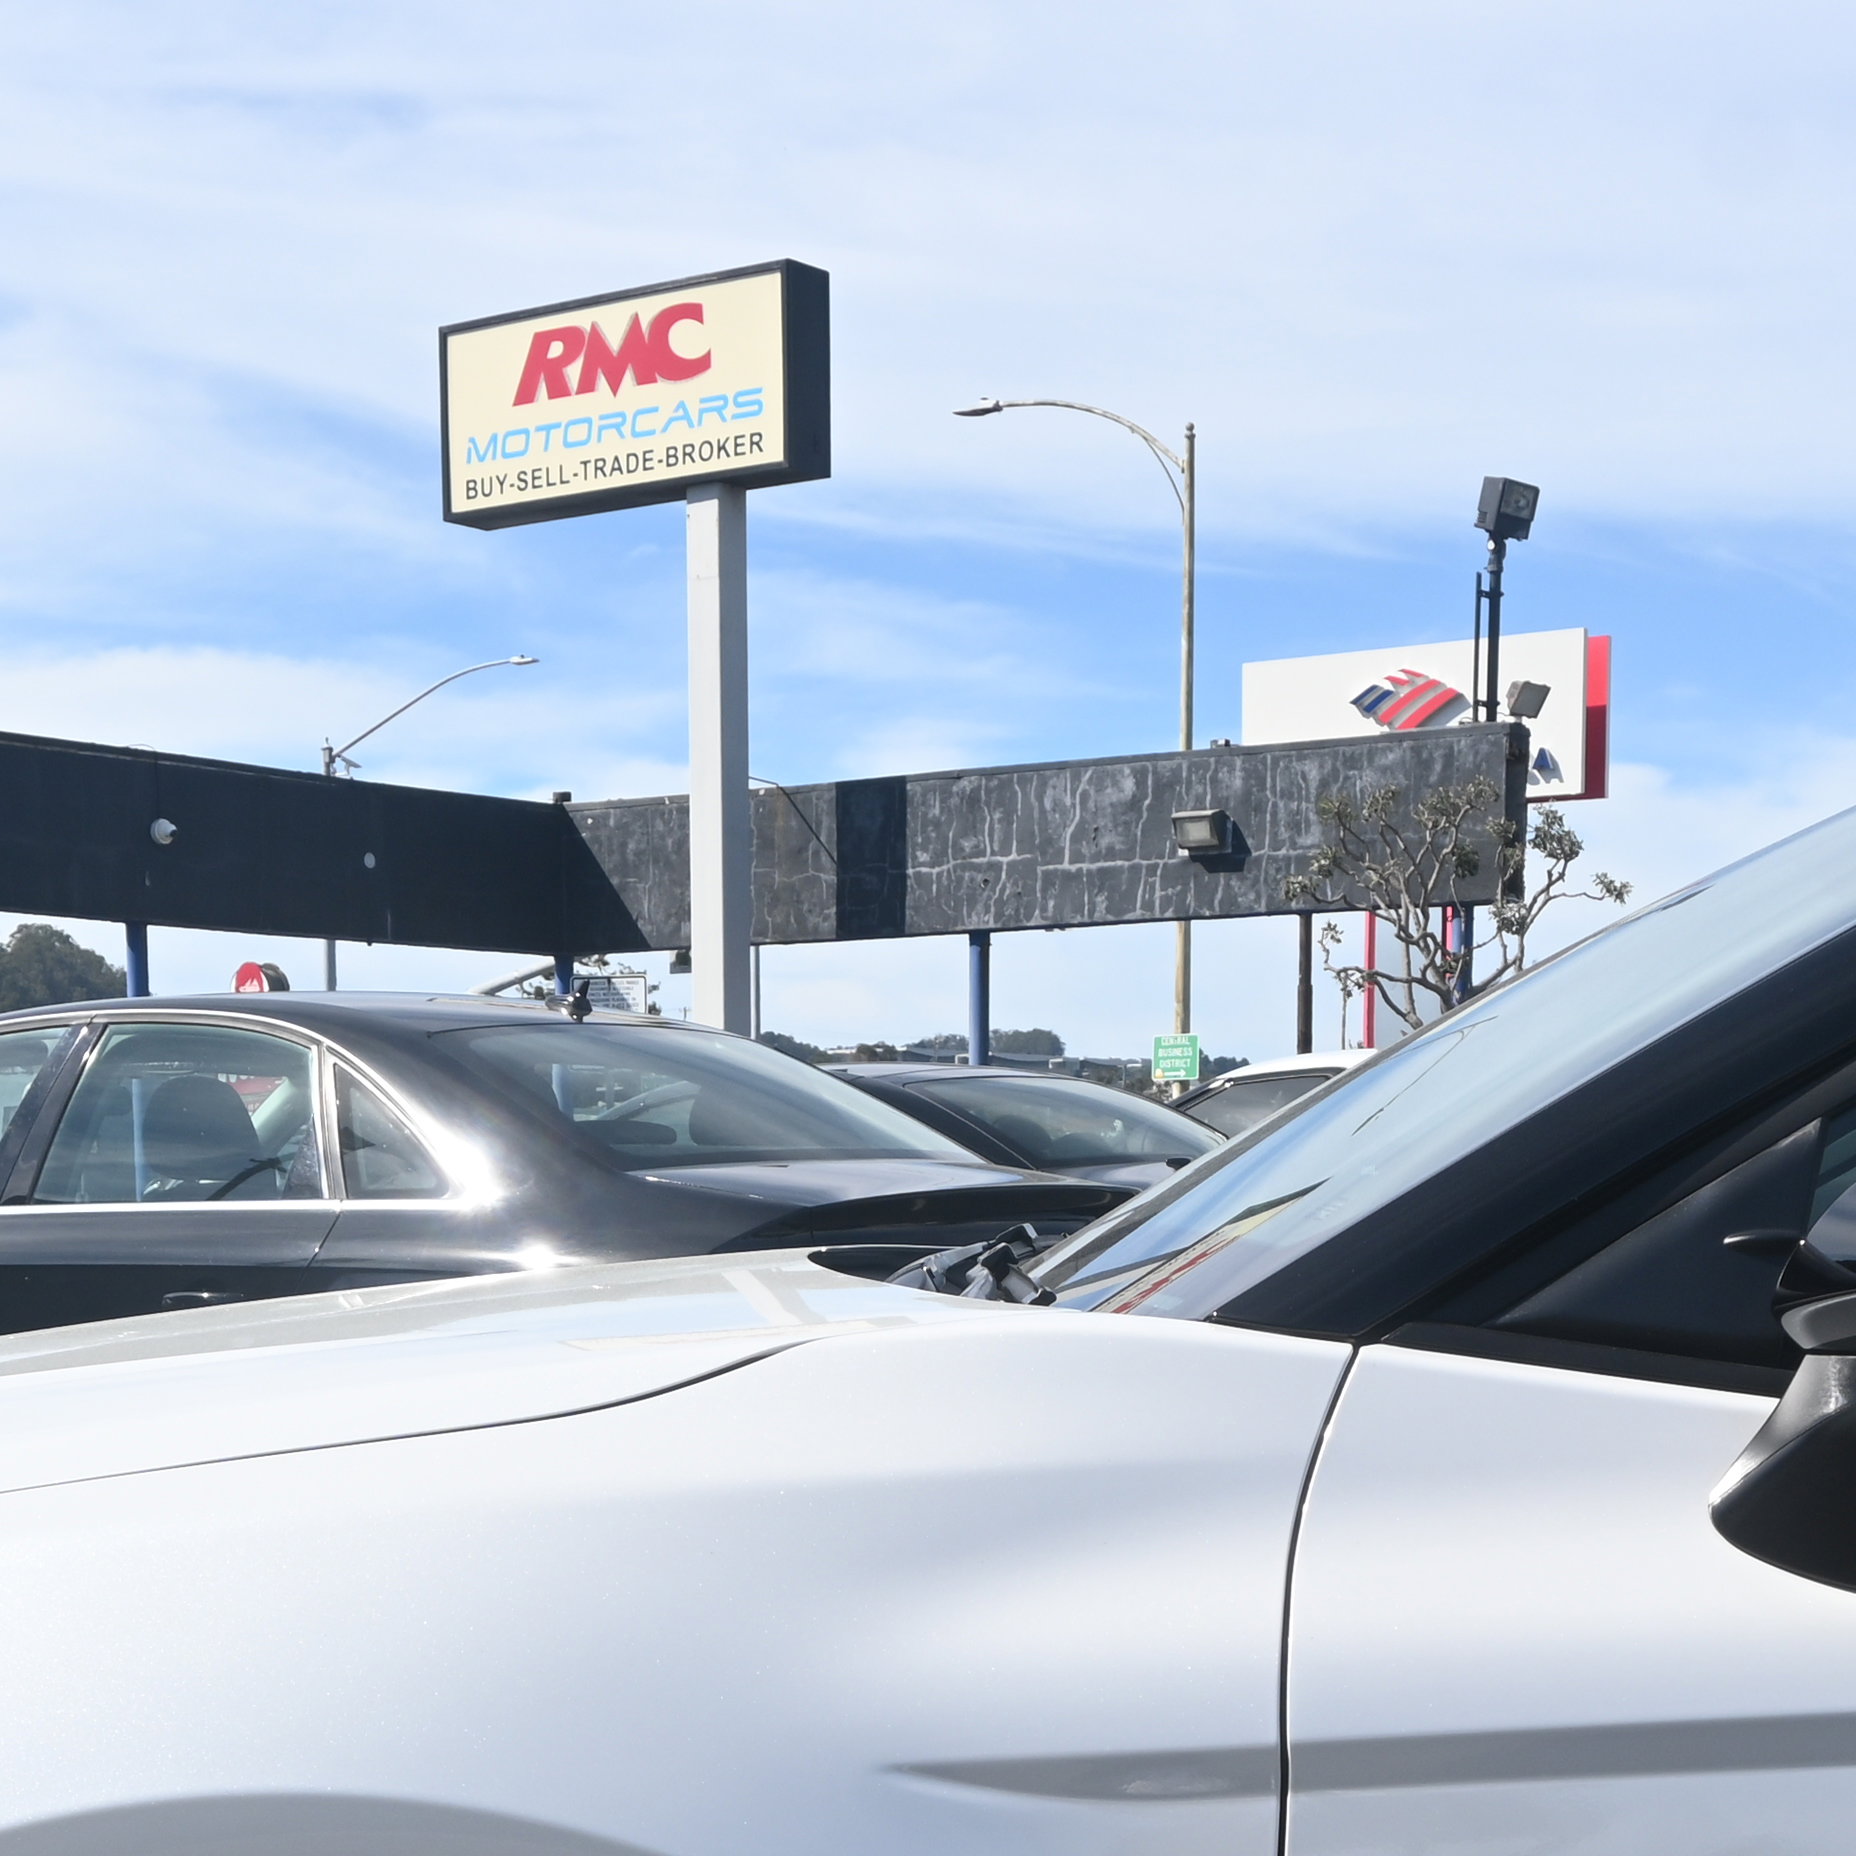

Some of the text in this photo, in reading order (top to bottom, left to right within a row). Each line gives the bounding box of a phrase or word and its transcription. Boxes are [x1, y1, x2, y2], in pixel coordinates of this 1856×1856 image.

[512, 302, 712, 407] RMC
[466, 386, 764, 464] MOTORCARS
[466, 431, 764, 500] BUY-SELL-TRADE-BROKER
[1158, 1047, 1193, 1057] BUSINESS
[1160, 1036, 1191, 1046] CENTRAL
[1159, 1058, 1191, 1068] DISTRICT
